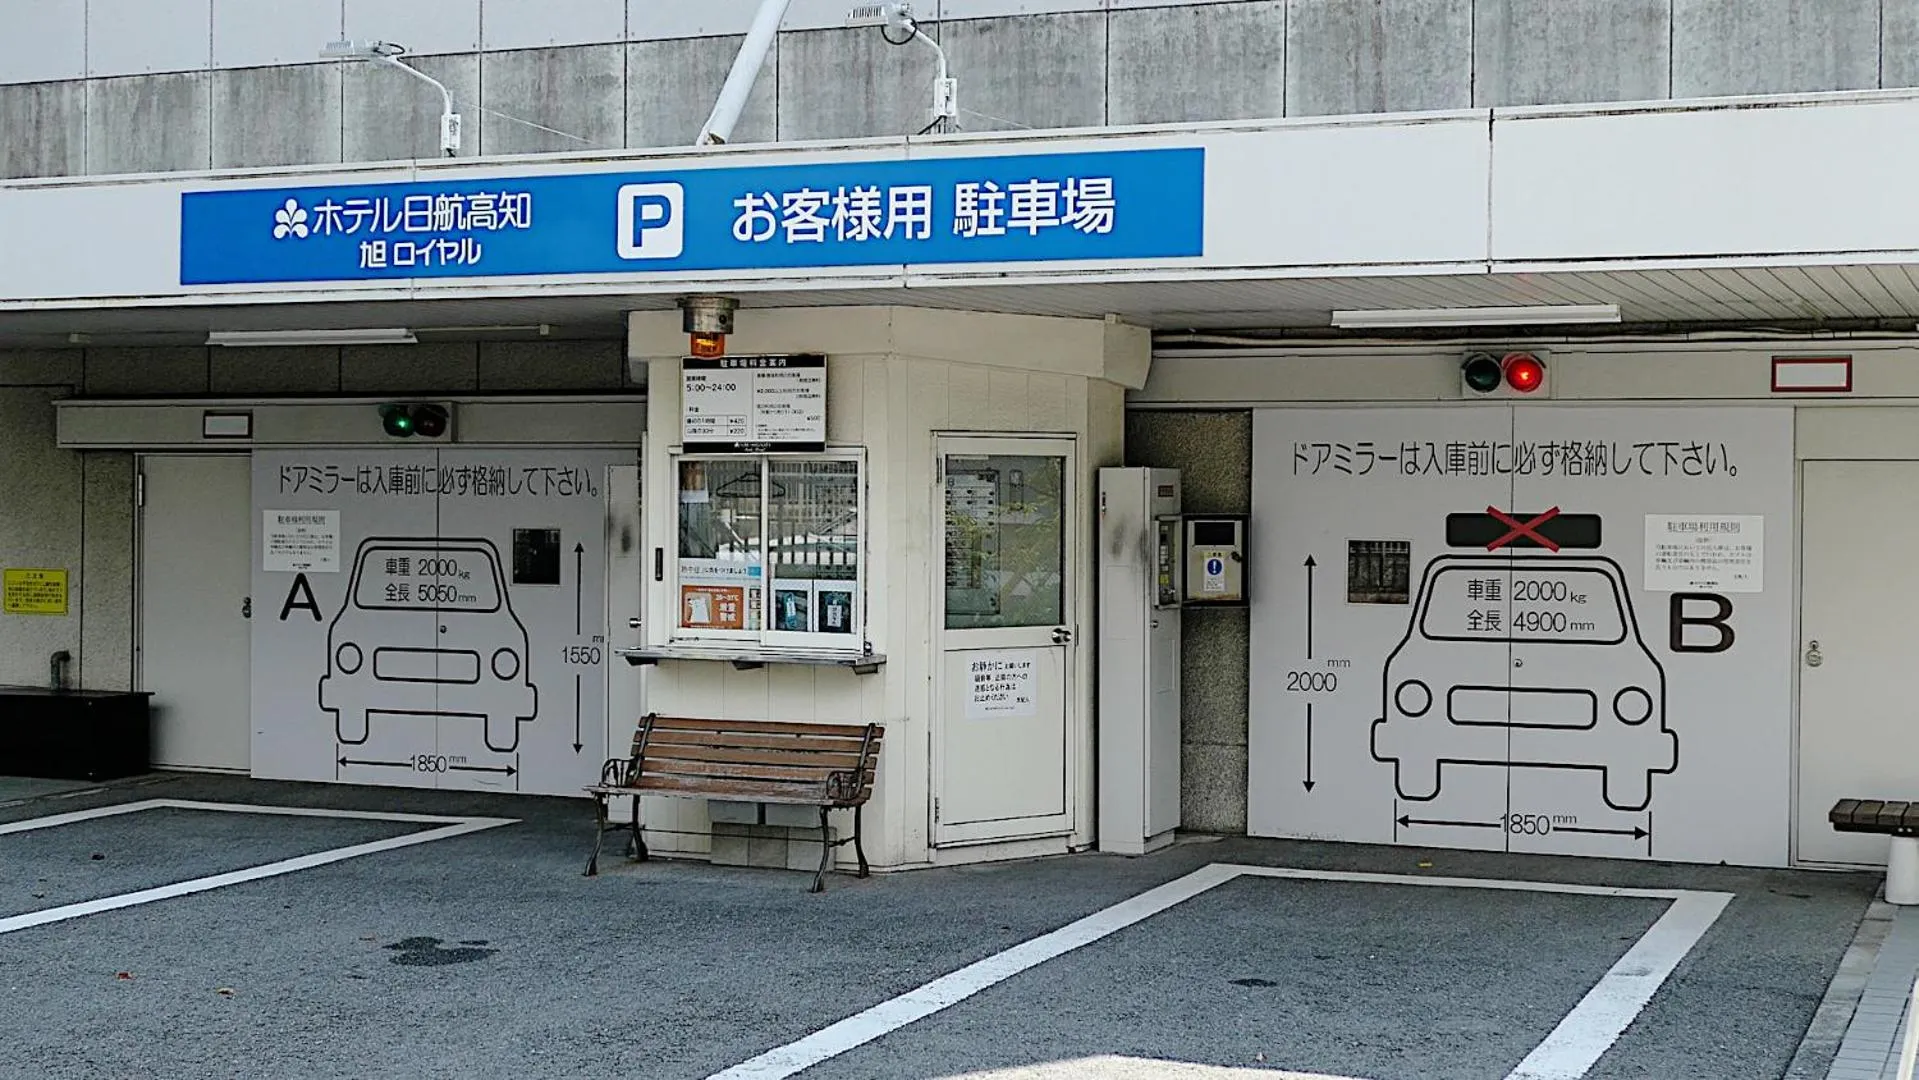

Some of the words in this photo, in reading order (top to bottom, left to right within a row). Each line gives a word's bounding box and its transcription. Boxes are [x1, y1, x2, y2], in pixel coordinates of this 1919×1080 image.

[313, 191, 531, 234] ホテル日航高知
[632, 195, 672, 248] P
[733, 185, 932, 243] お客様用
[952, 177, 1115, 235] 駐車場
[360, 241, 387, 268] 旭
[393, 238, 482, 267] ロイヤル
[1292, 440, 1738, 477] ドアミラーは入庫前に必ず格納して下さい。
[278, 465, 599, 497] ドアミラーは入庫前に必ず格納して下さい。
[385, 558, 410, 576] 車重
[280, 572, 322, 622] A
[385, 583, 410, 603] 全長
[1467, 579, 1502, 601] 車重
[1467, 609, 1502, 632] 全長
[1669, 592, 1735, 653] B
[562, 646, 601, 665] 1550
[1286, 672, 1337, 692] 2000
